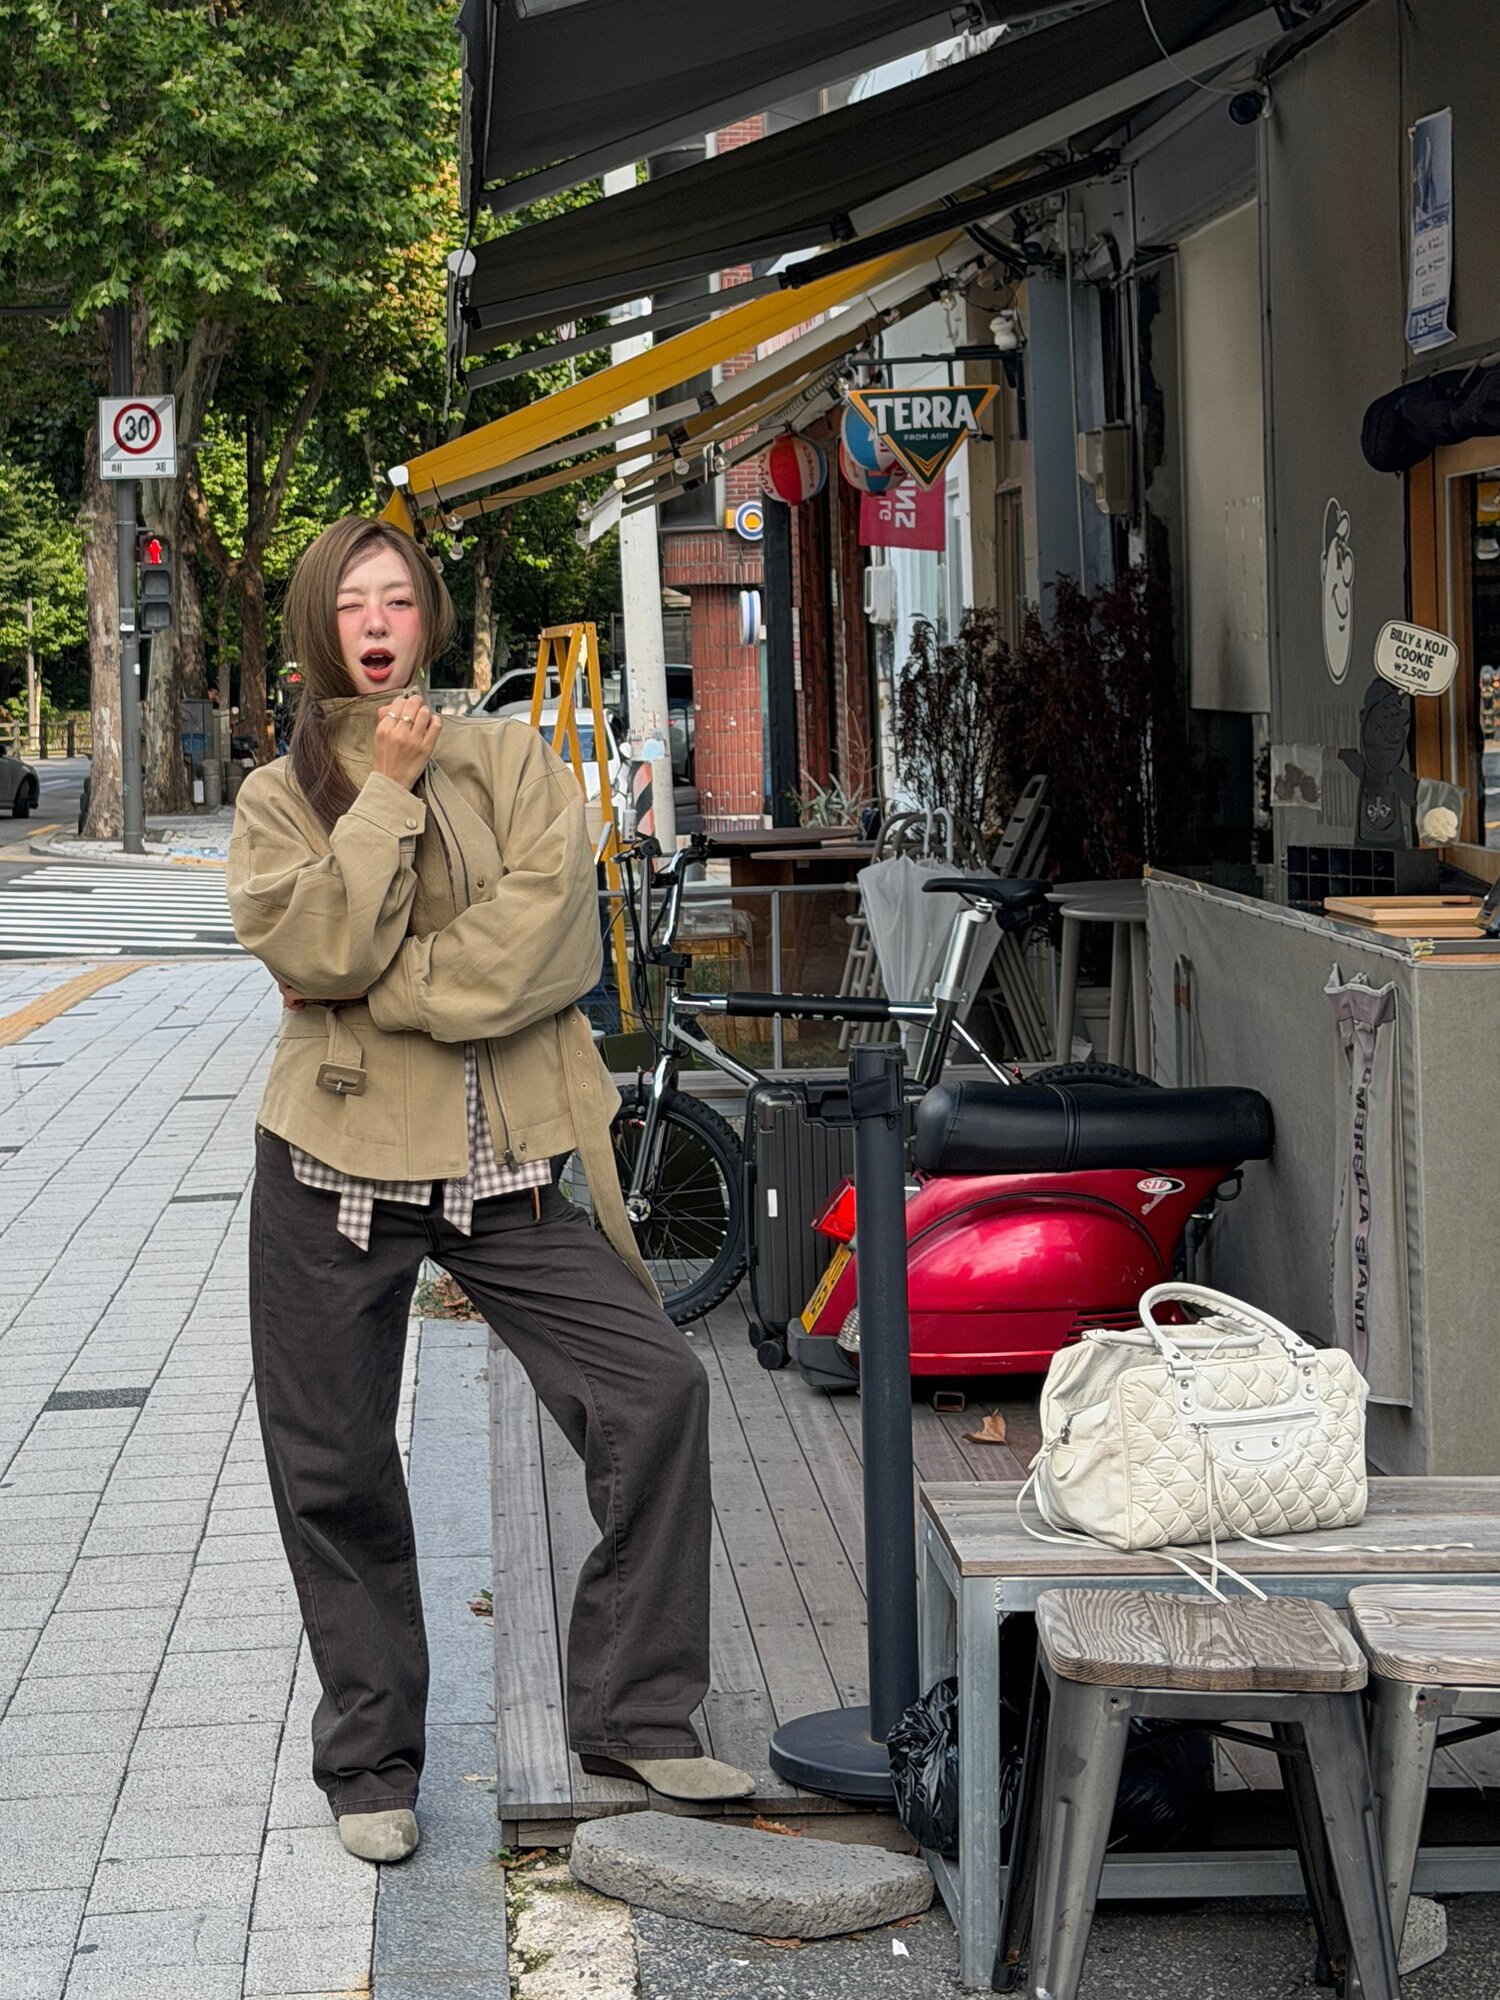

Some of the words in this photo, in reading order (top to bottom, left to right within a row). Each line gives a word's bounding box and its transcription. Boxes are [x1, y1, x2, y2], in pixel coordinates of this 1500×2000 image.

[125, 415, 150, 442] 30
[868, 394, 979, 435] TERRA
[1390, 627, 1416, 646] BILLY
[1415, 637, 1422, 649] &
[1424, 638, 1449, 658] KOJI
[1395, 645, 1435, 669] COOKIE
[1354, 1235, 1369, 1332] STAND
